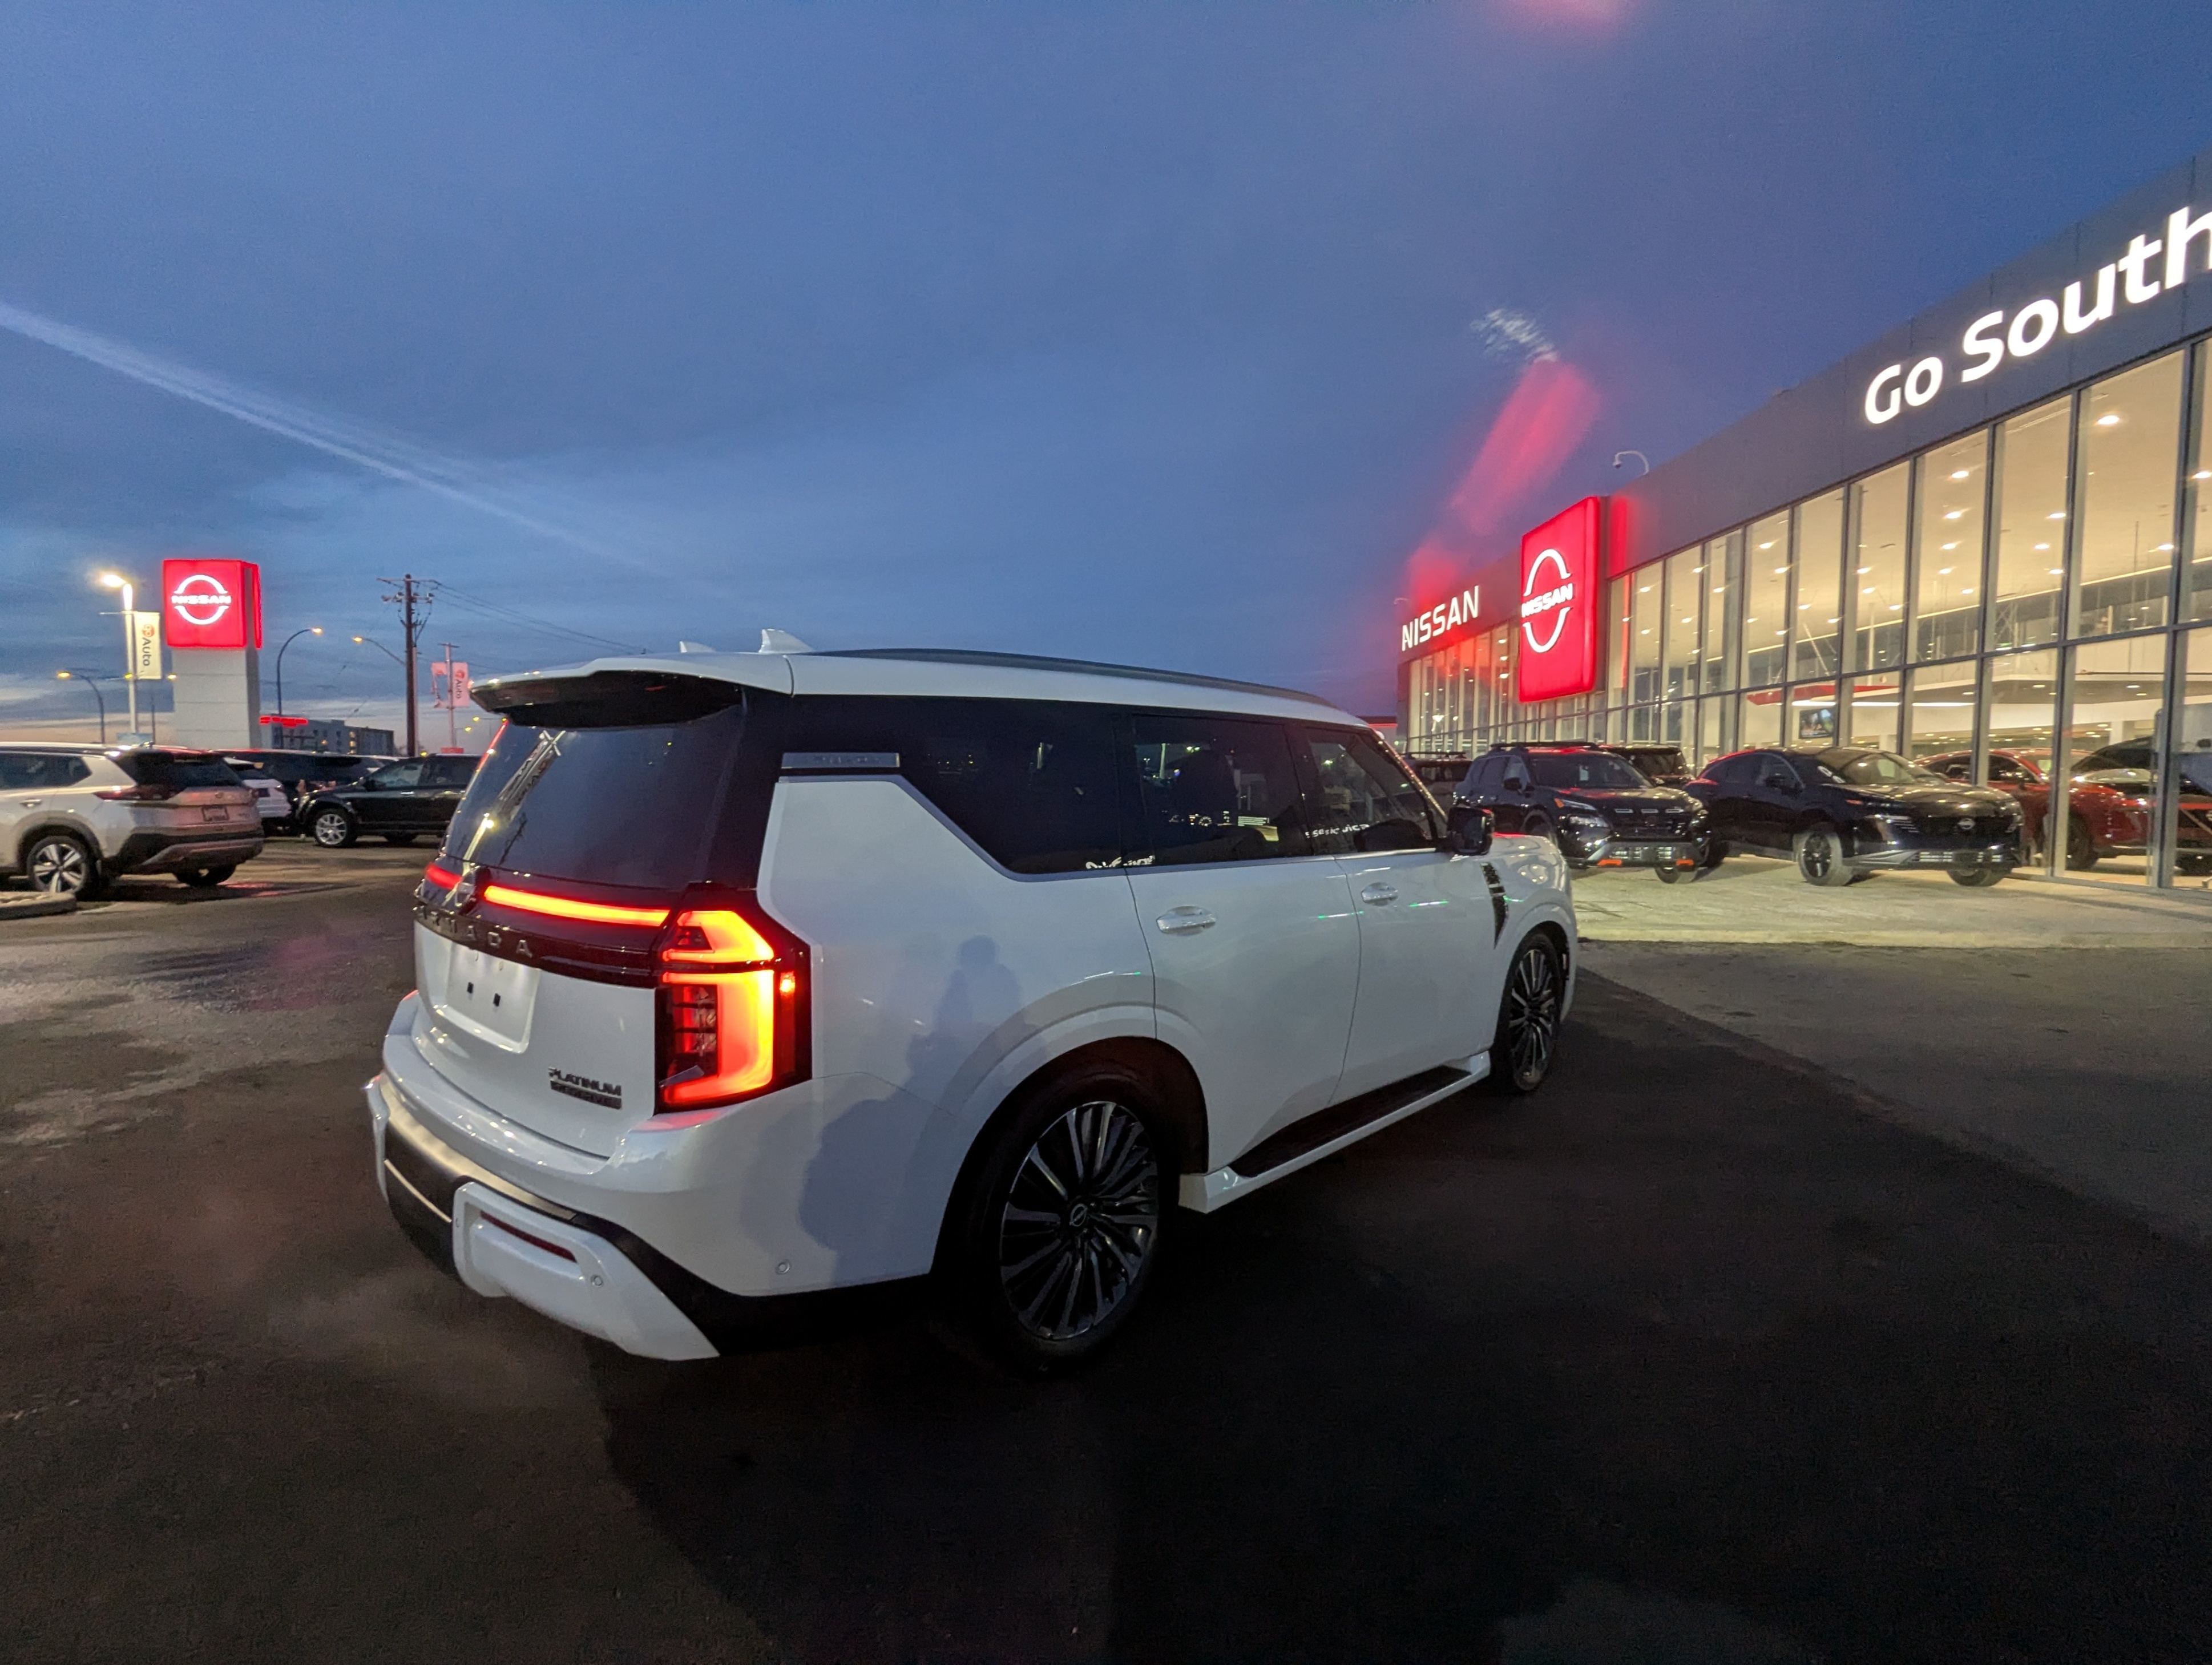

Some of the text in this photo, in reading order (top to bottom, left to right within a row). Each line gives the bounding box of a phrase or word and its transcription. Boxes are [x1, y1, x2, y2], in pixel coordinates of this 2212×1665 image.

[1864, 206, 2212, 425] Go South
[171, 595, 232, 605] NISSAN
[1521, 583, 1573, 618] NISSAN
[1402, 585, 1479, 651] NISSAN
[548, 1066, 621, 1096] PLATINUM
